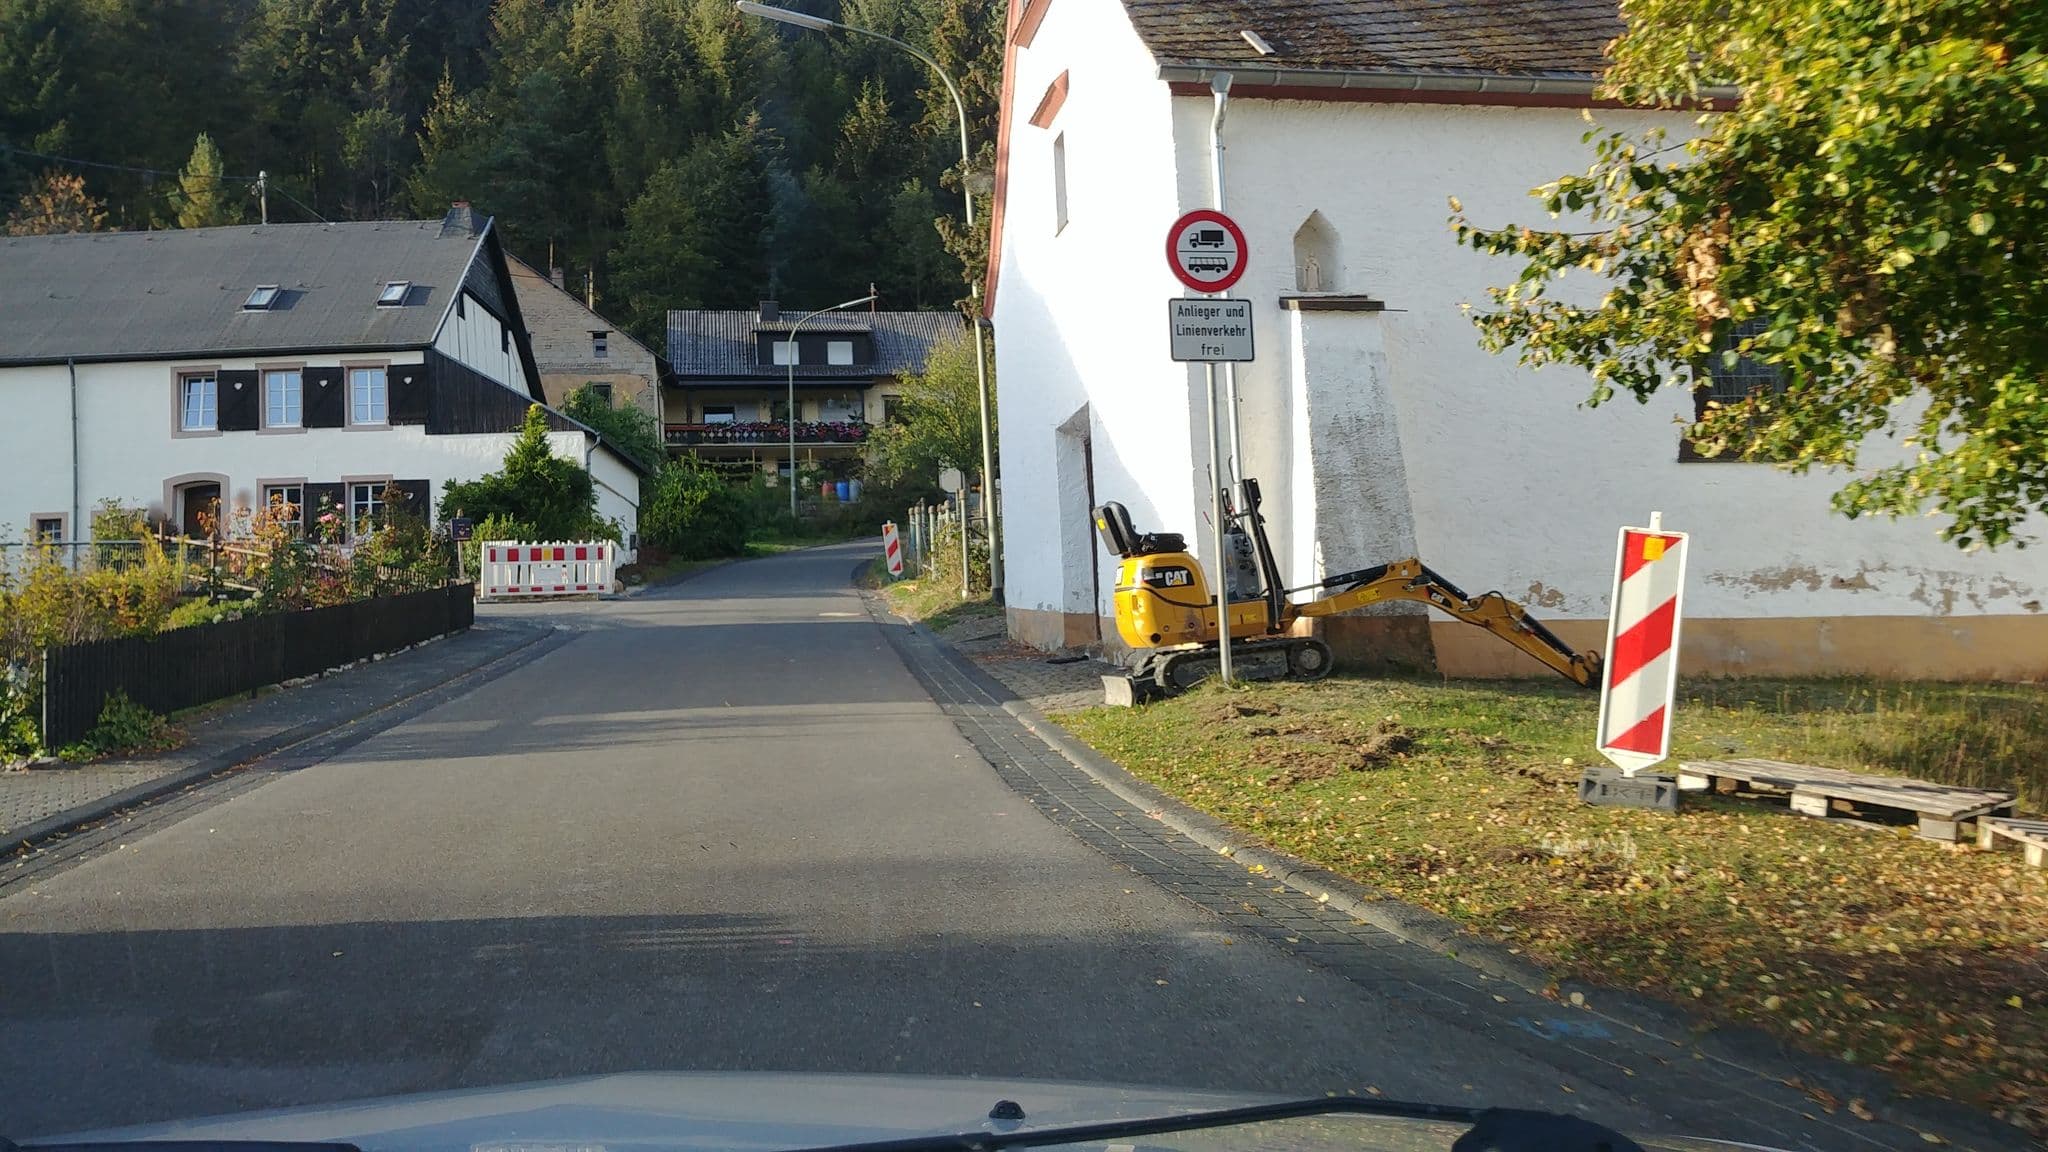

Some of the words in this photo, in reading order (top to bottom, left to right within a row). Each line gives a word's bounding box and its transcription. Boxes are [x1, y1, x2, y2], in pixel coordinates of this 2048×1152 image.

[1177, 305, 1220, 320] Anlieger
[1226, 305, 1244, 317] und
[1176, 324, 1247, 337] Linienverkehr
[1201, 343, 1225, 356] frei
[1165, 570, 1188, 586] CAT
